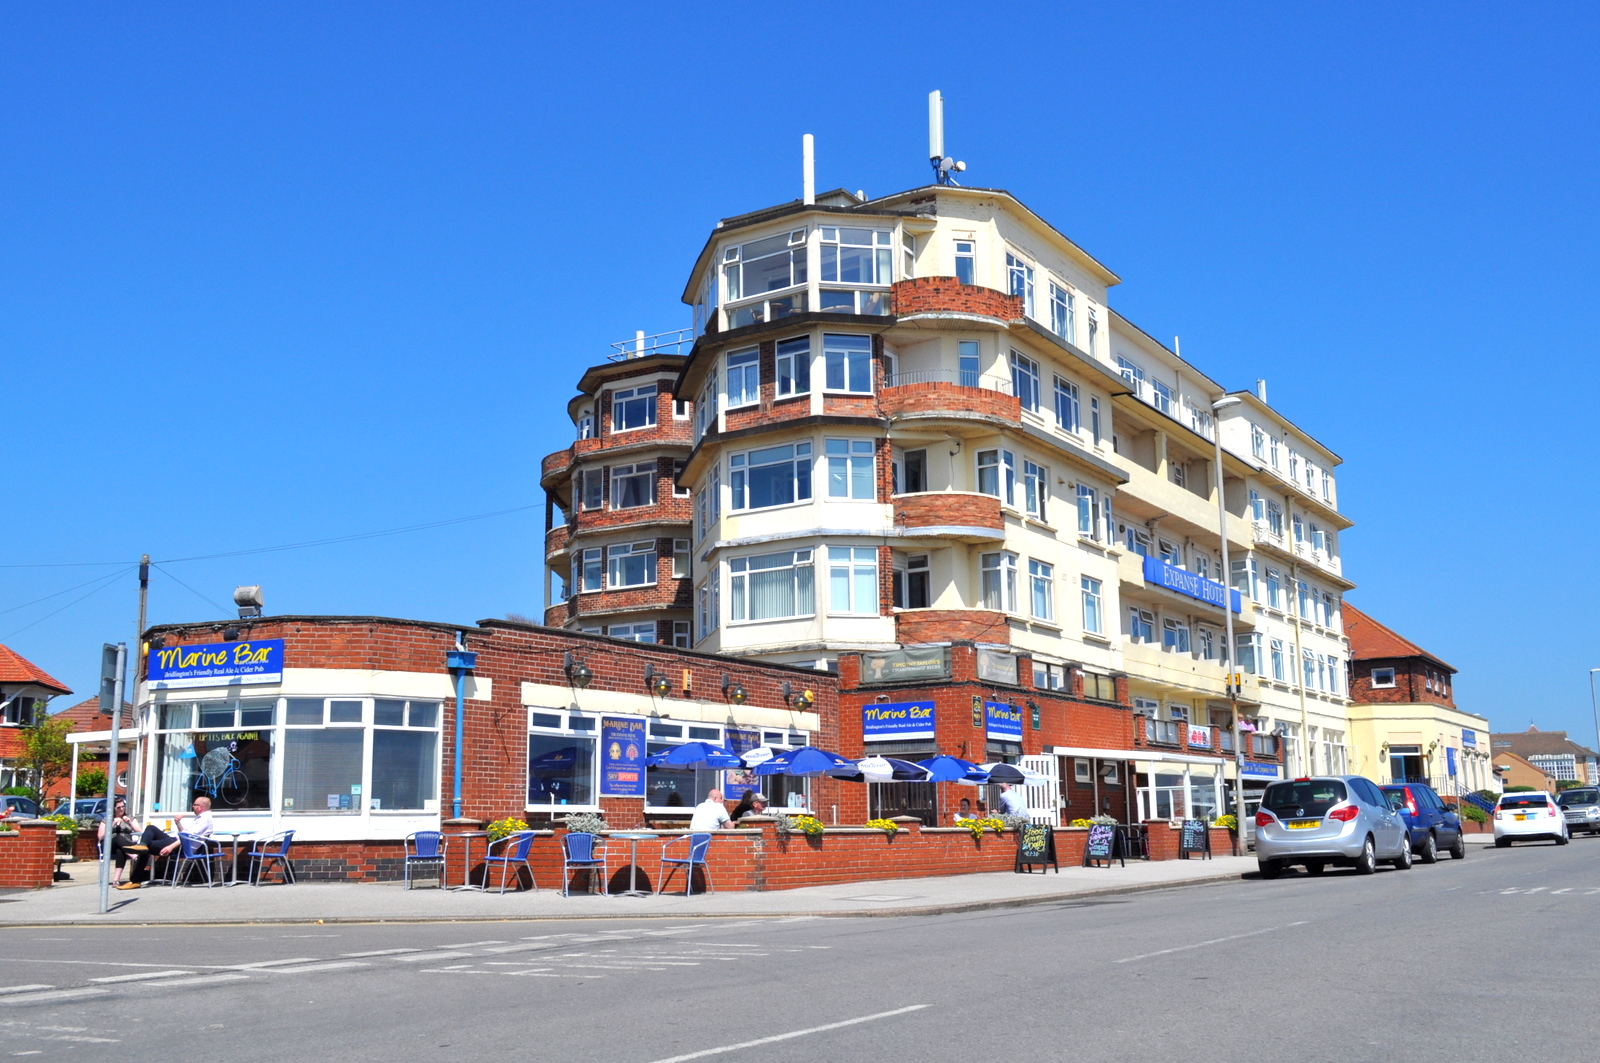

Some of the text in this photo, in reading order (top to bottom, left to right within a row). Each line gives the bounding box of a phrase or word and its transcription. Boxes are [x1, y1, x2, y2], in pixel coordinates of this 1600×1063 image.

[1163, 565, 1200, 596] EXPANSE
[157, 643, 273, 669] Marine Bar
[193, 668, 213, 677] Friendly
[865, 706, 932, 720] Marine Bar
[987, 706, 1009, 720] Marine
[603, 720, 646, 732] MARINE BAR
